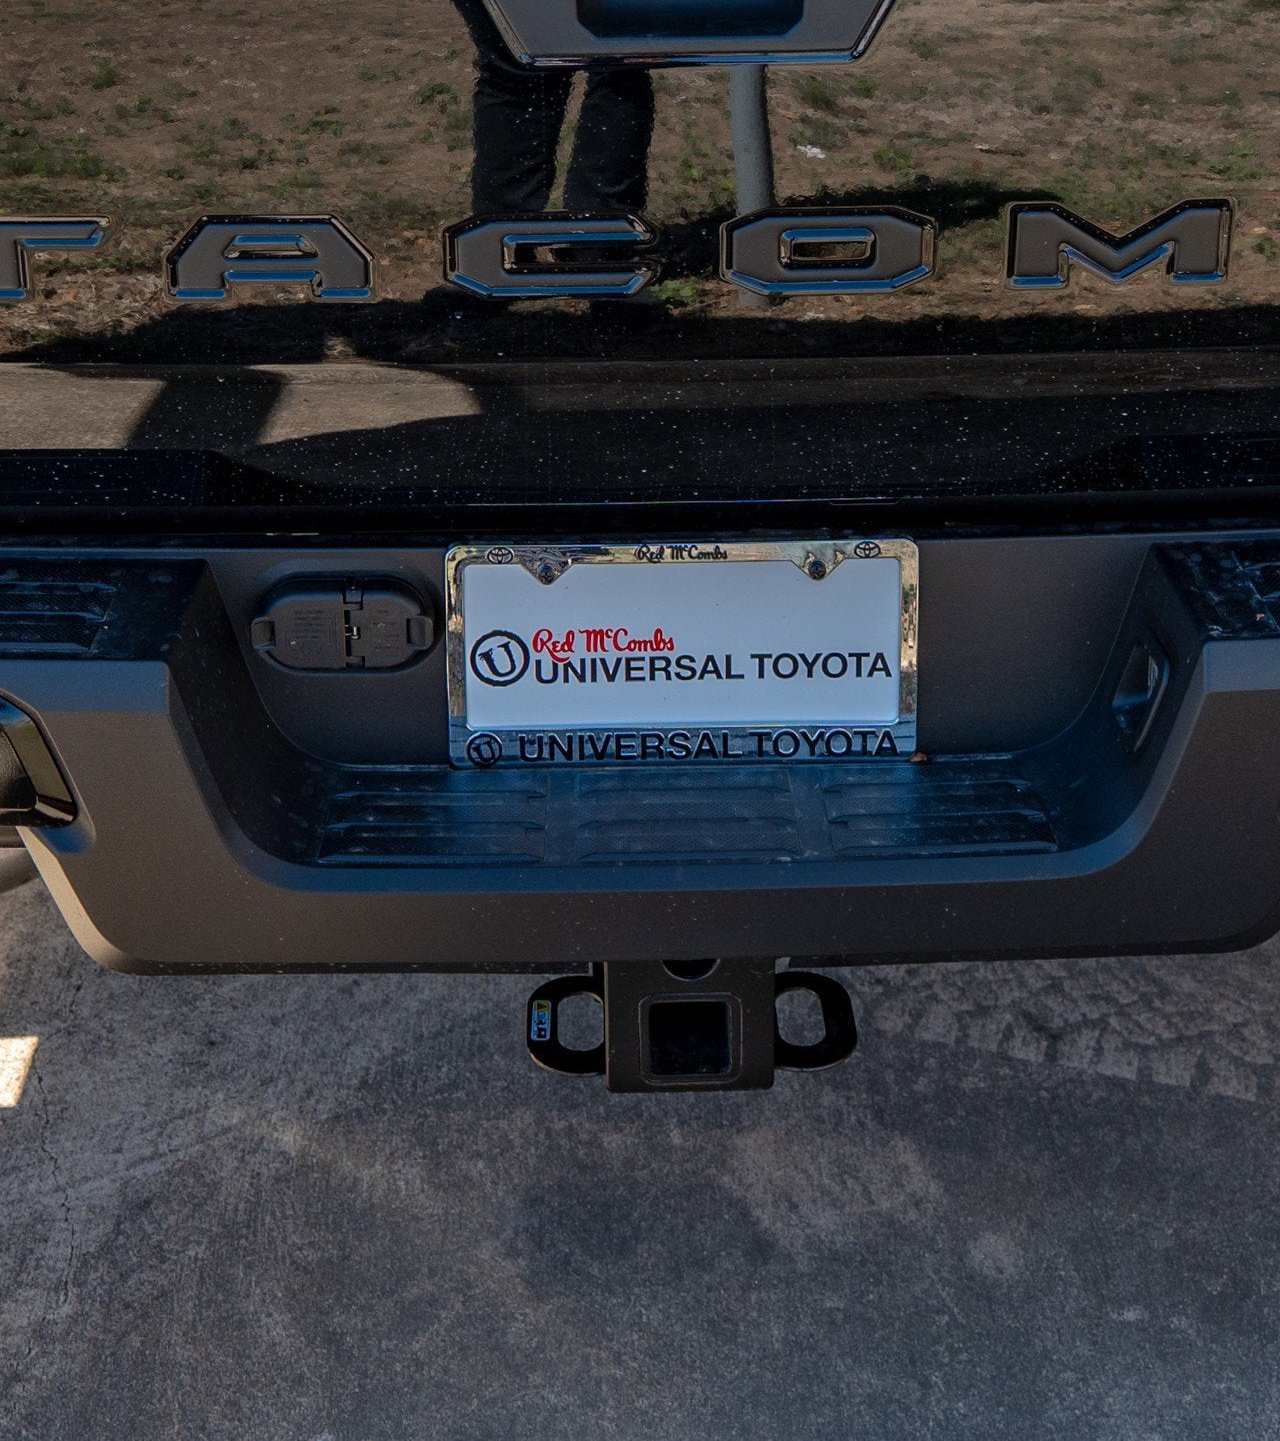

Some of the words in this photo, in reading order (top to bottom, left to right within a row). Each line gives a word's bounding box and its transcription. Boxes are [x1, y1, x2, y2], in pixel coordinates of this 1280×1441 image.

[634, 544, 665, 564] Red
[532, 628, 575, 663] Red
[578, 628, 675, 653] McCombs
[534, 654, 745, 685] UNIVERSAL
[749, 652, 893, 680] TOYOTA
[518, 729, 743, 763] UNIVERSAL
[748, 728, 900, 758] TOYOTA
